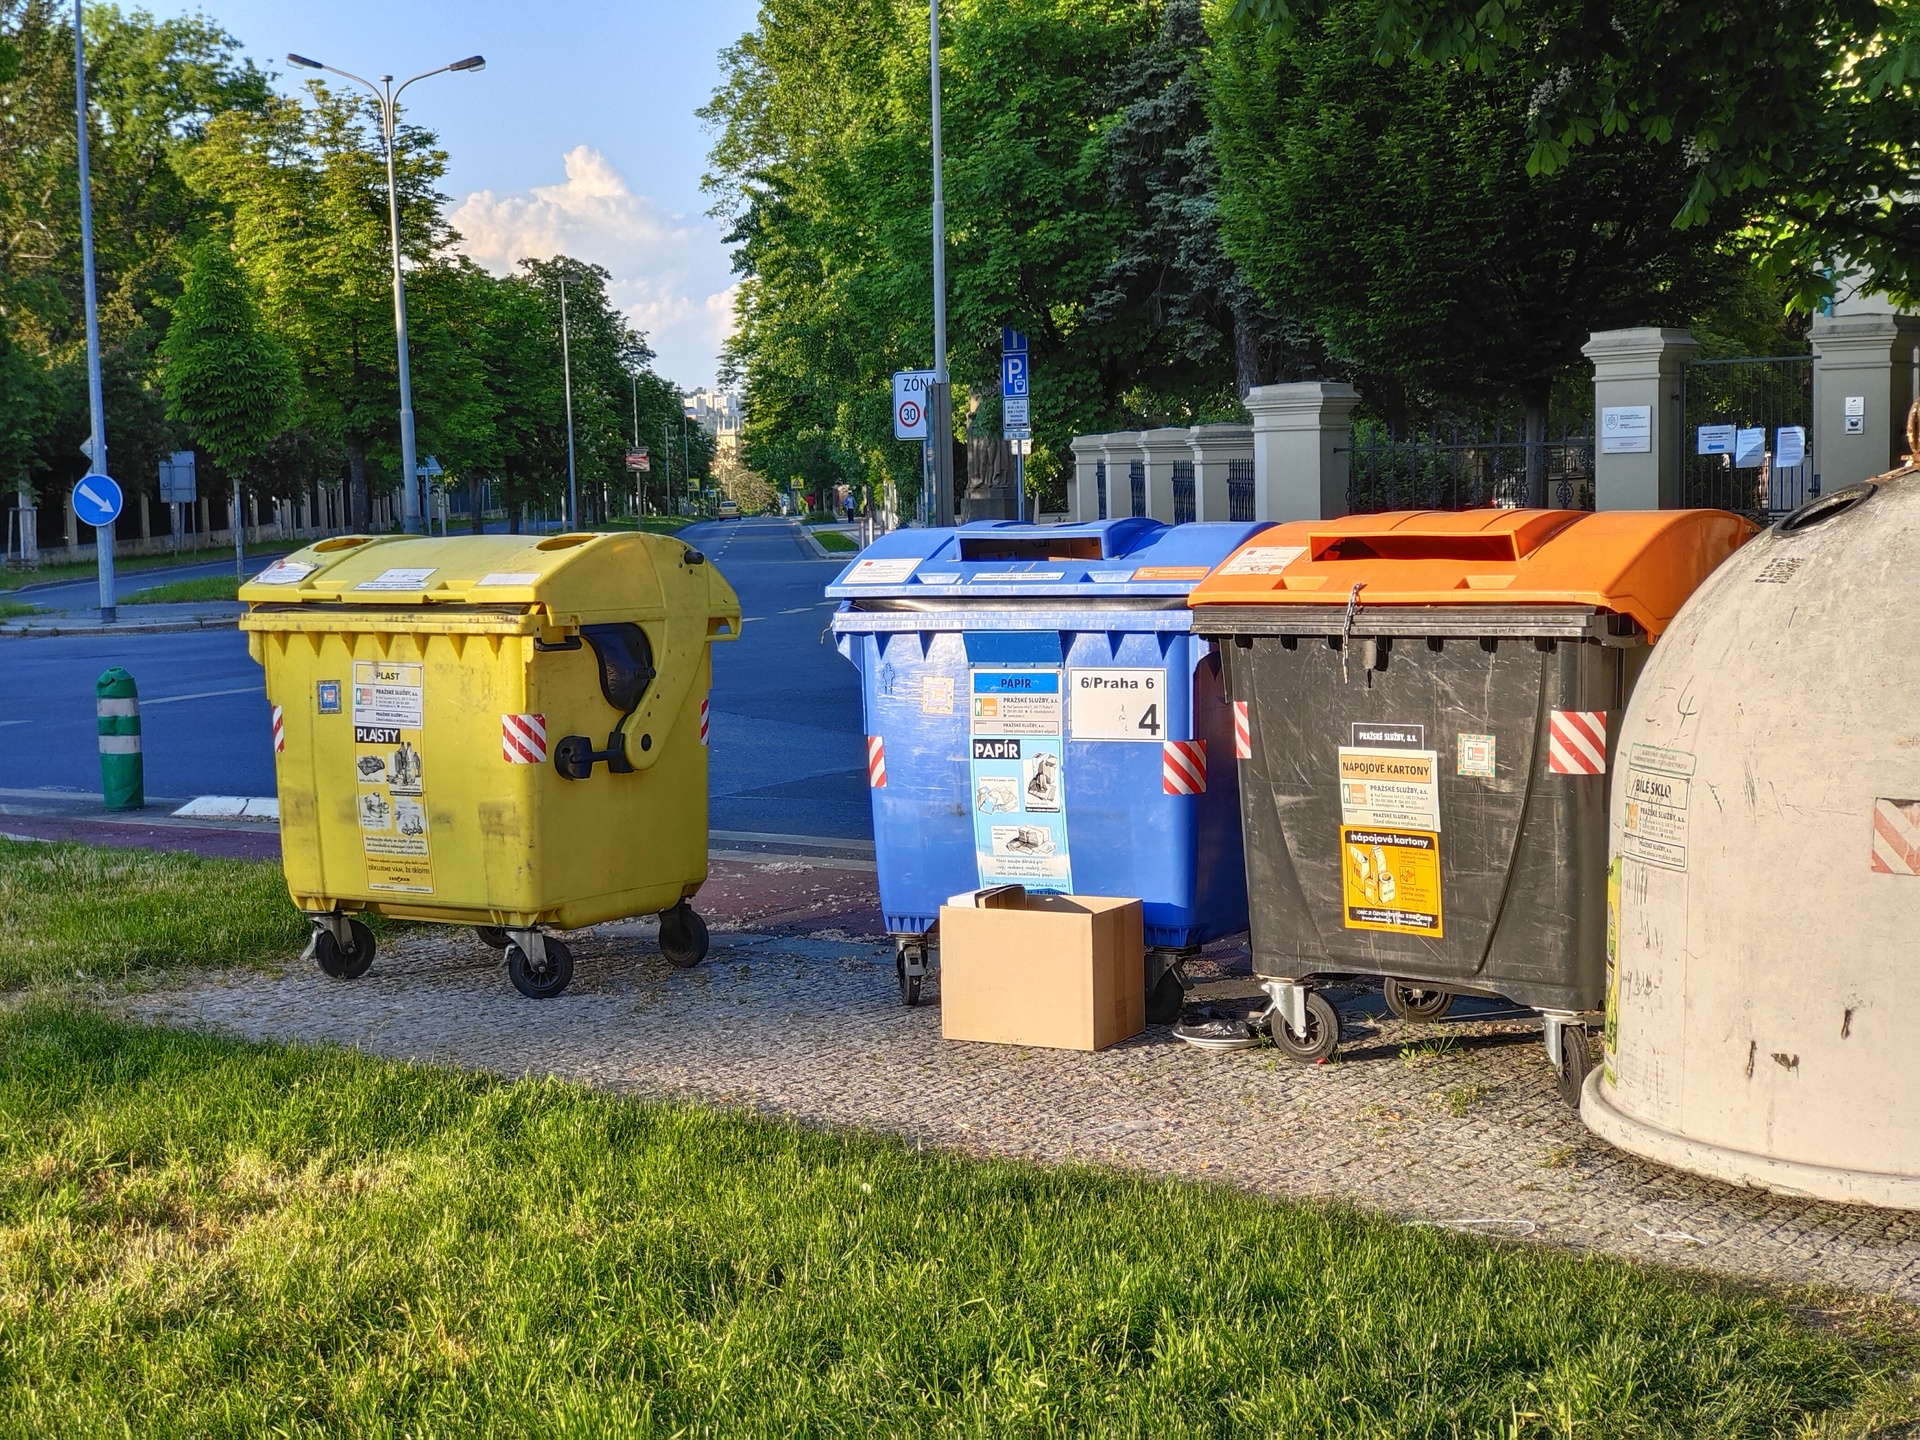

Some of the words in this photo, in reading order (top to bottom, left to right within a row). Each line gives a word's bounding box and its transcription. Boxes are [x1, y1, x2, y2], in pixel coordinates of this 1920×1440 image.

[903, 408, 916, 420] 30
[1001, 676, 1031, 688] PAPÍR
[1081, 676, 1138, 689] 6/Praha
[1145, 677, 1154, 689] 6
[1138, 704, 1160, 736] 4
[357, 728, 398, 742] PLASTY
[1359, 731, 1383, 740] PRAŽSKÉ
[1384, 732, 1405, 742] SLUŽBY,
[975, 740, 1018, 758] PAPÍR
[1343, 760, 1385, 774] NÁPOJOVÉ
[1387, 764, 1429, 776] KARTONY
[1370, 784, 1394, 792] PRAŽSKÉ
[1396, 786, 1419, 794] SLUŽBY,
[1636, 776, 1650, 794] BÍLÉ
[1651, 780, 1671, 798] SKLO
[1351, 833, 1393, 844] nápojové
[1394, 835, 1428, 848] kartony
